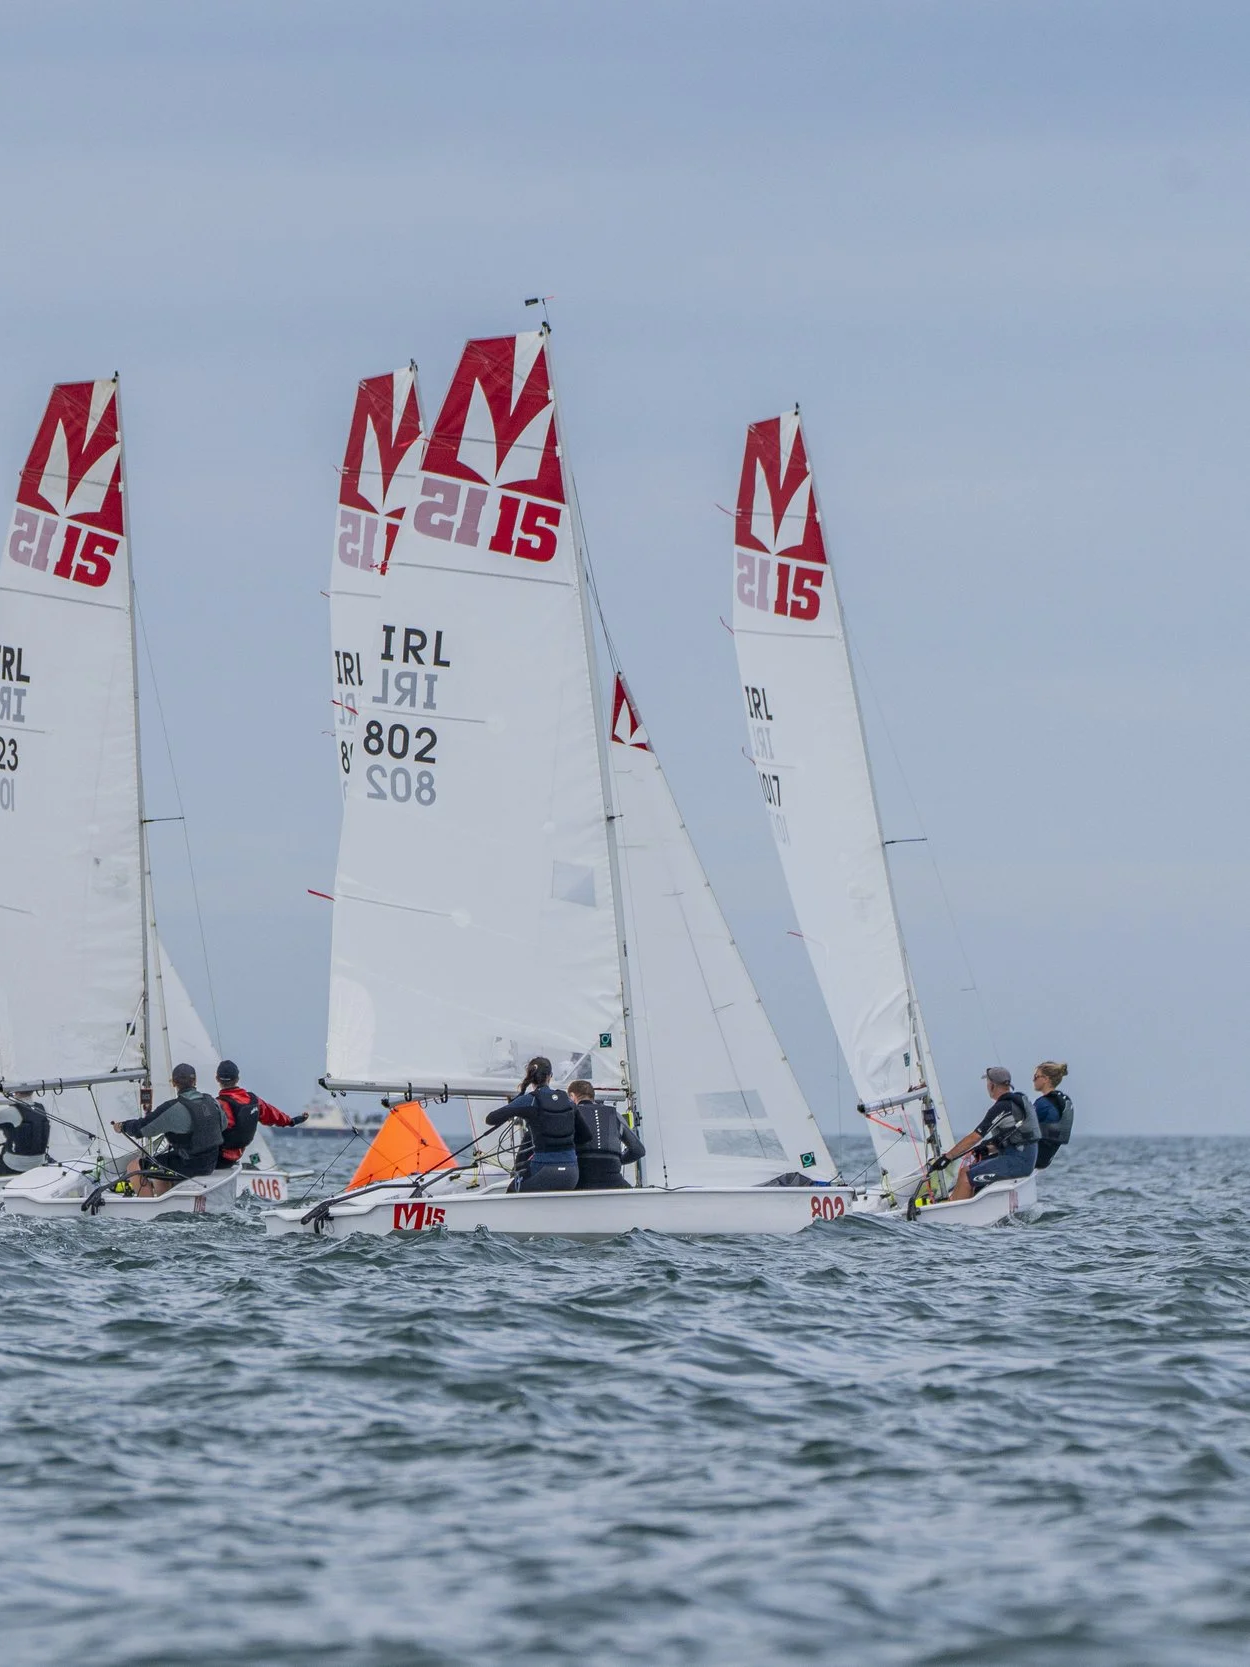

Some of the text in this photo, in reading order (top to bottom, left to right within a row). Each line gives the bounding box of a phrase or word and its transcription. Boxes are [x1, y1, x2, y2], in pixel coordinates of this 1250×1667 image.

[489, 494, 562, 562] 15
[53, 524, 120, 588] 15
[774, 563, 824, 621] 15
[381, 624, 450, 667] IRL
[744, 685, 773, 721] IRL
[363, 720, 437, 764] 802
[252, 1178, 281, 1200] 1016
[811, 1196, 844, 1222] 802
[393, 1203, 446, 1230] M15
